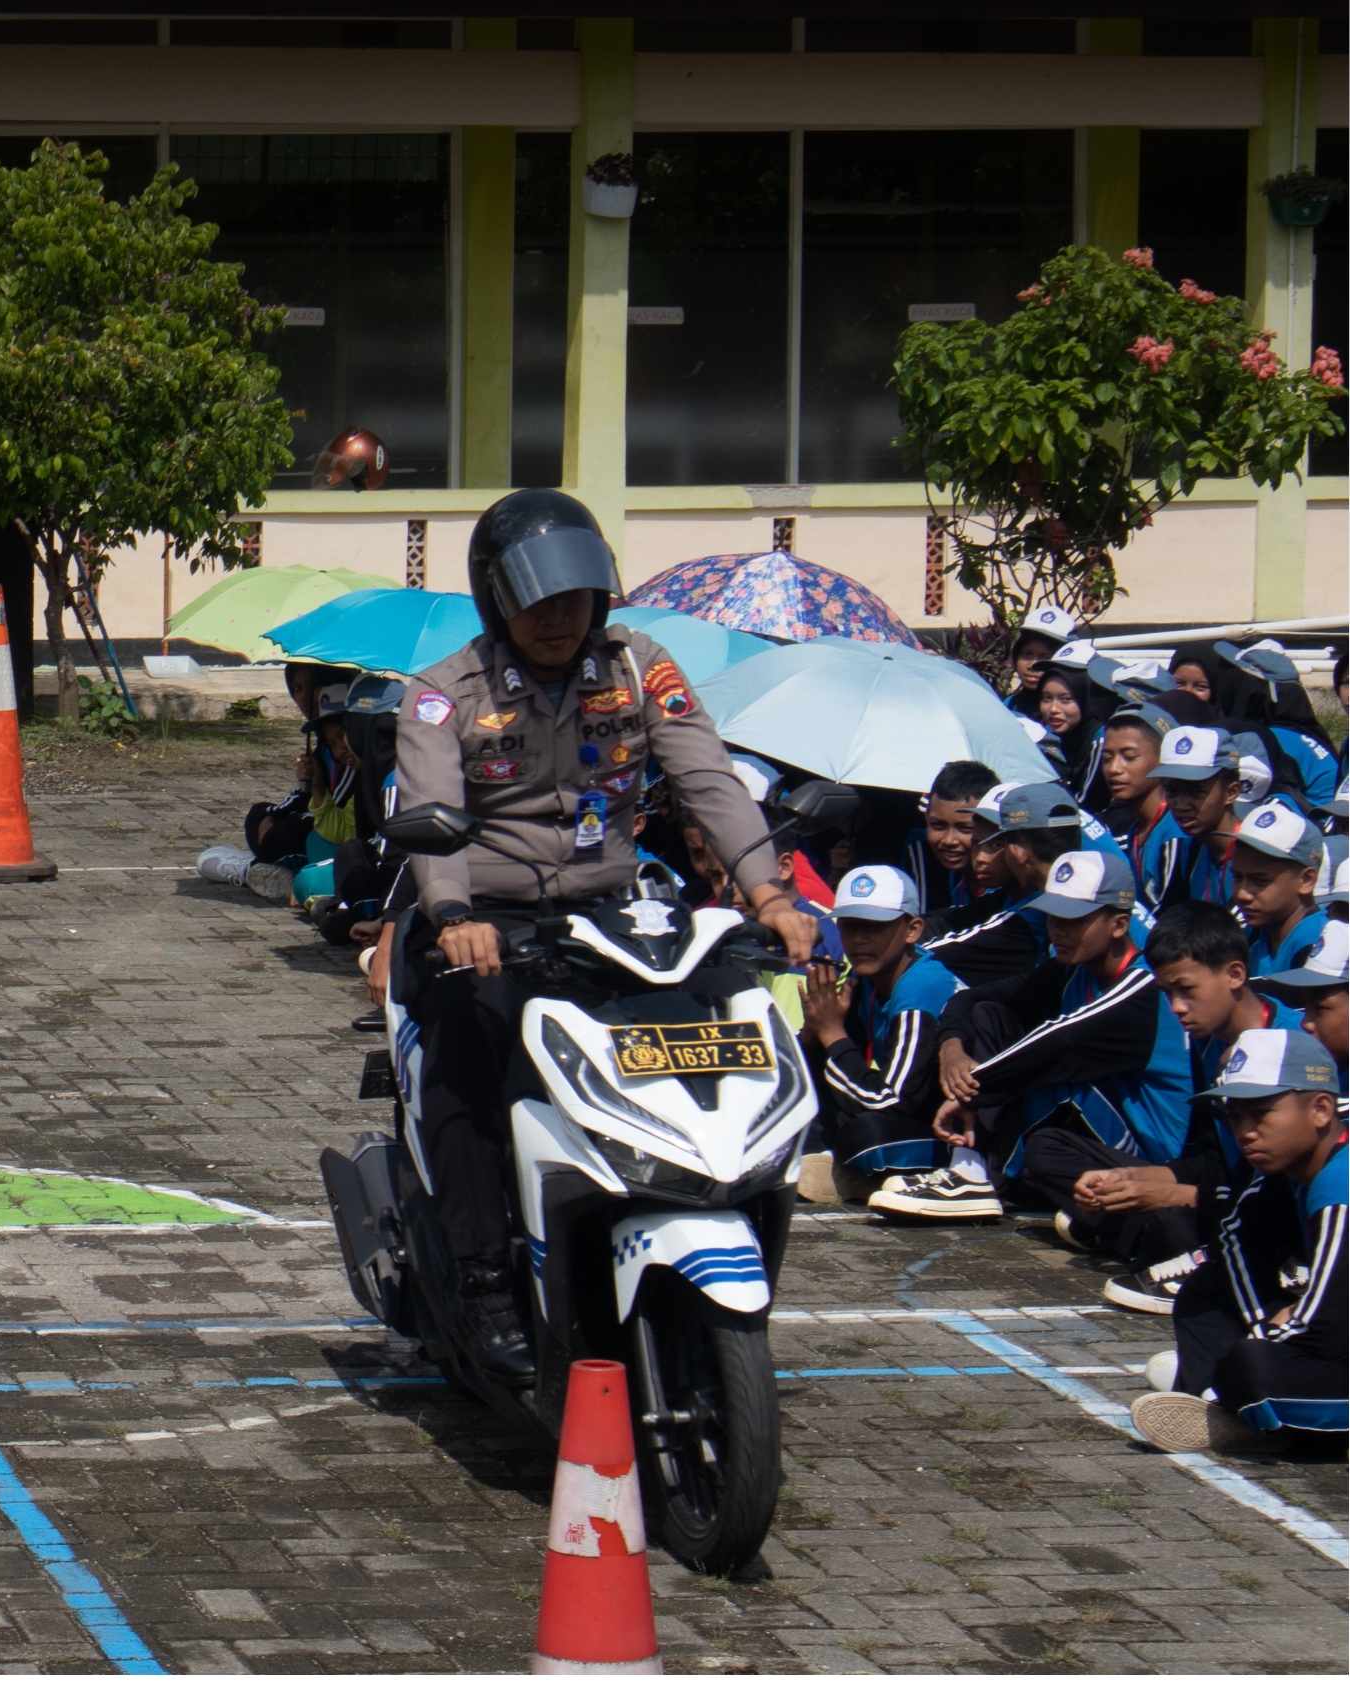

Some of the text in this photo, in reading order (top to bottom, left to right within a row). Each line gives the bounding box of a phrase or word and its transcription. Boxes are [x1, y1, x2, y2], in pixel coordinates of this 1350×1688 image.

[293, 311, 322, 321] KACA
[628, 311, 650, 320] WAS
[911, 307, 972, 317] AWAS KACA
[582, 716, 643, 741] POLRI
[479, 734, 524, 755] ADI
[698, 1026, 722, 1040] IX
[673, 1045, 719, 1067] 1637
[736, 1044, 766, 1065] 33
